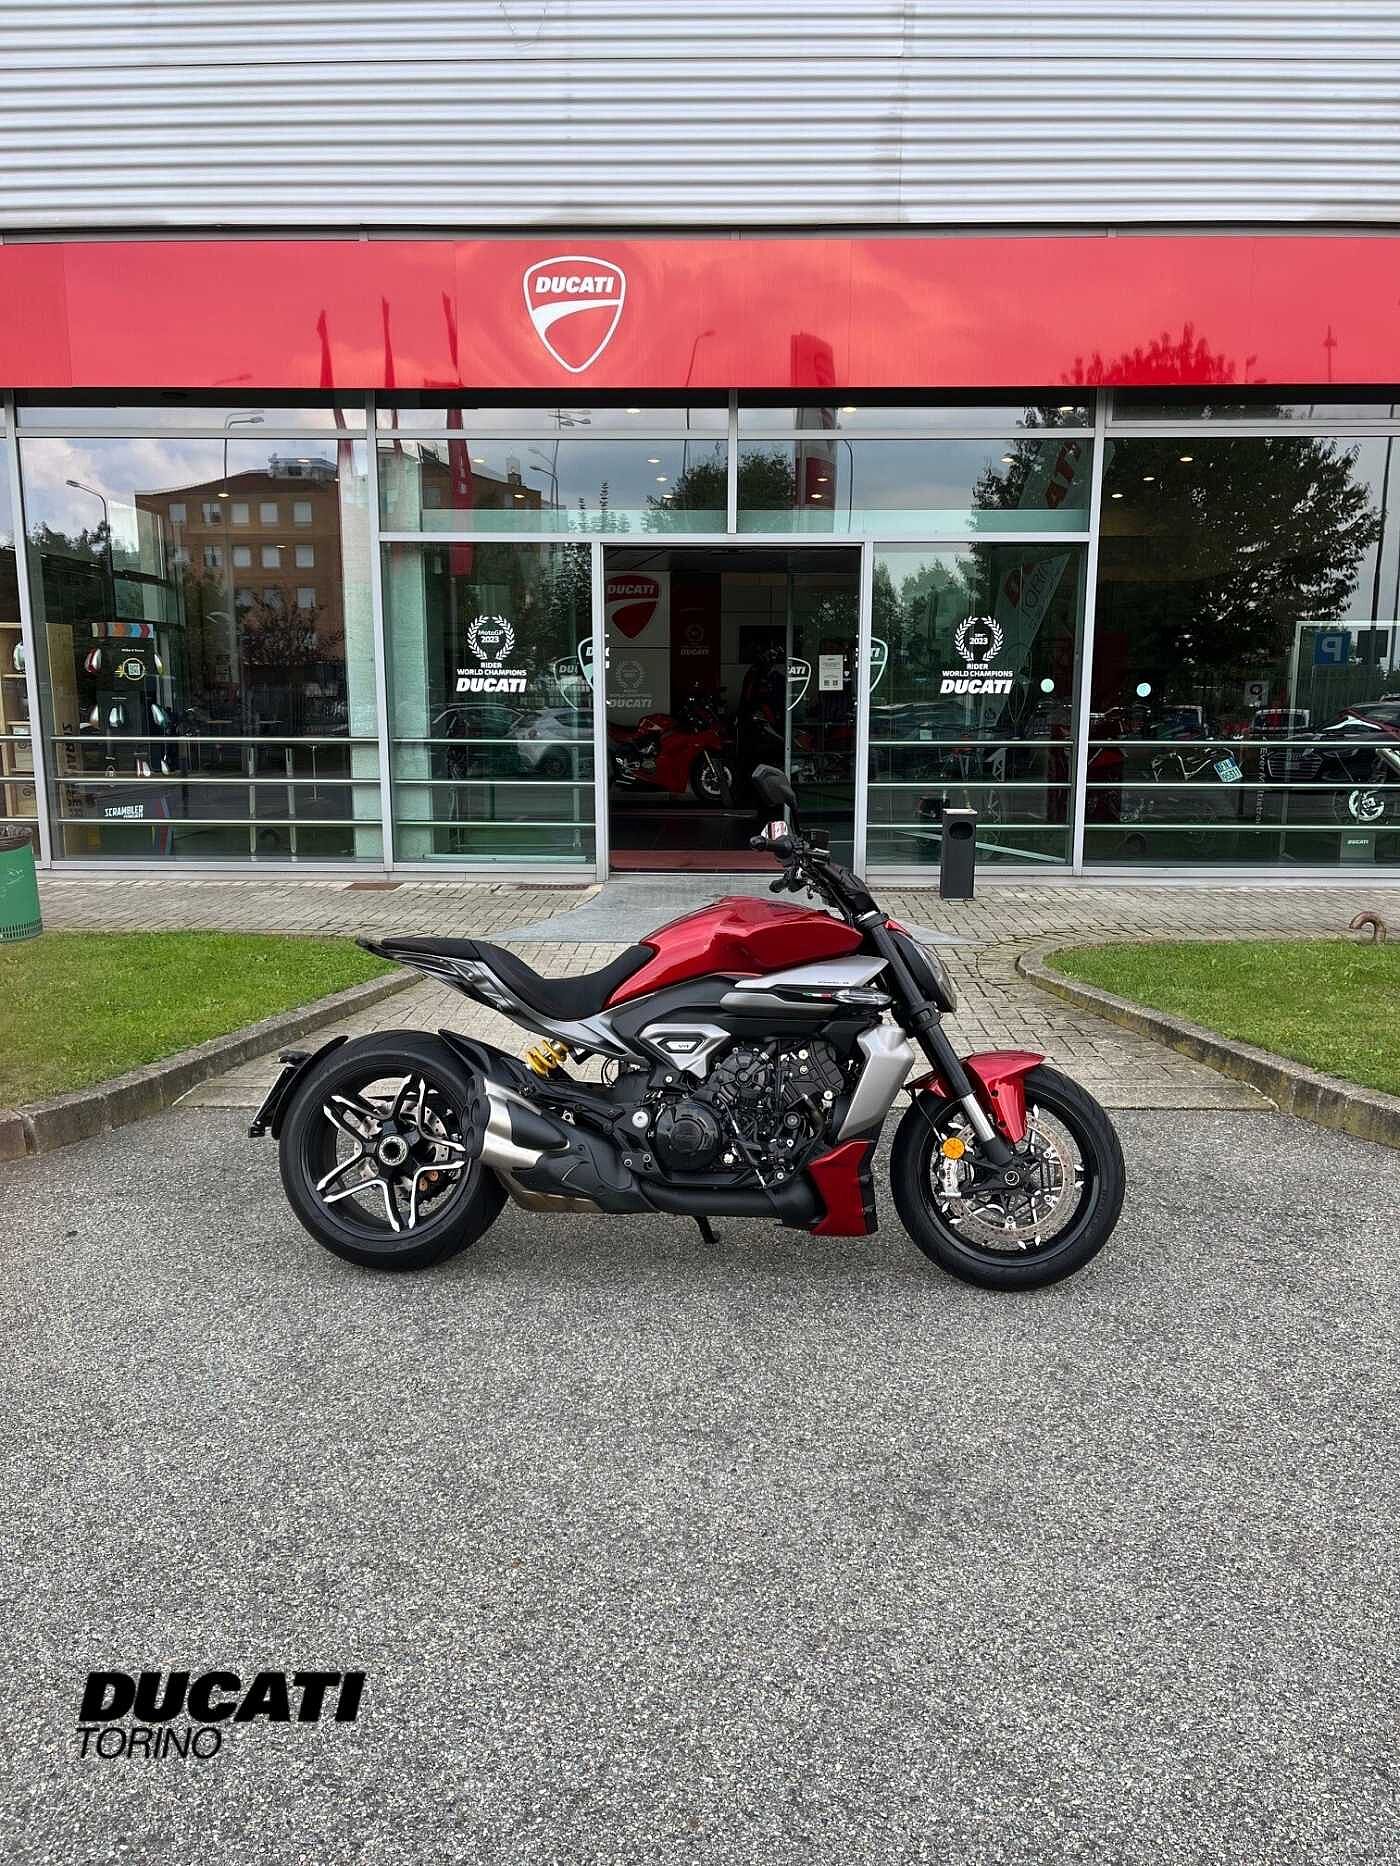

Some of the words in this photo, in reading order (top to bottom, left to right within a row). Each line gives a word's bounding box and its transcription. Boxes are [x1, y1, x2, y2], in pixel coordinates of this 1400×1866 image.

[535, 276, 615, 293] DUCATI
[607, 584, 655, 595] DUCATI
[480, 635, 500, 643] 2023
[969, 637, 988, 645] 2023
[456, 668, 484, 676] WORLD
[484, 668, 527, 677] CHAMPIONS
[456, 677, 527, 693] DUCATI
[940, 679, 1013, 694] DUCATI
[104, 804, 144, 818] SCRAMBLER
